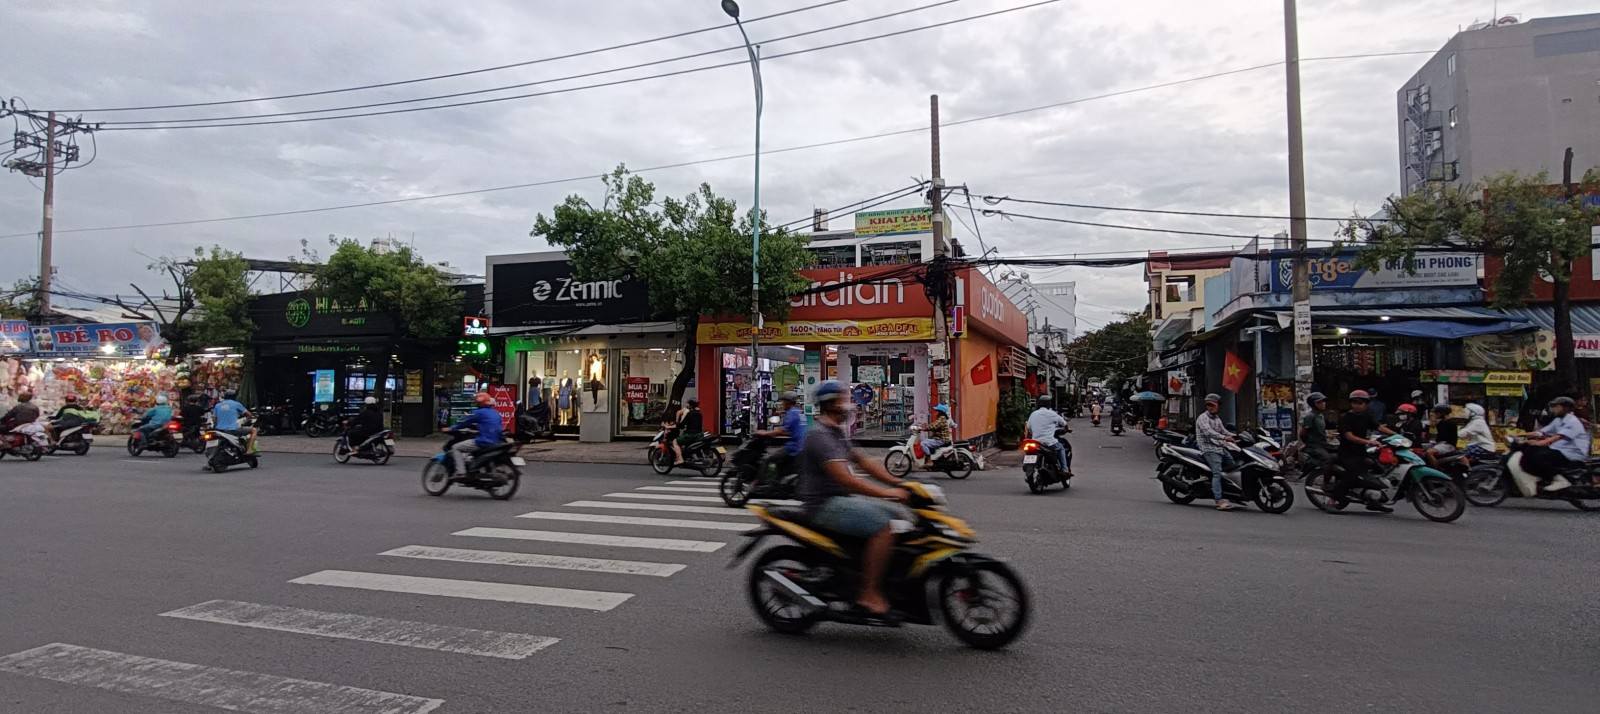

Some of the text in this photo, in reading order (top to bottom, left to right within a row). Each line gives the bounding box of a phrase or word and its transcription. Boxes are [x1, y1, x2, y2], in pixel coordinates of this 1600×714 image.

[1430, 256, 1472, 269] PHONG
[556, 277, 623, 301] Zennic
[789, 271, 904, 308] ardian
[56, 326, 134, 344] BÉ BO
